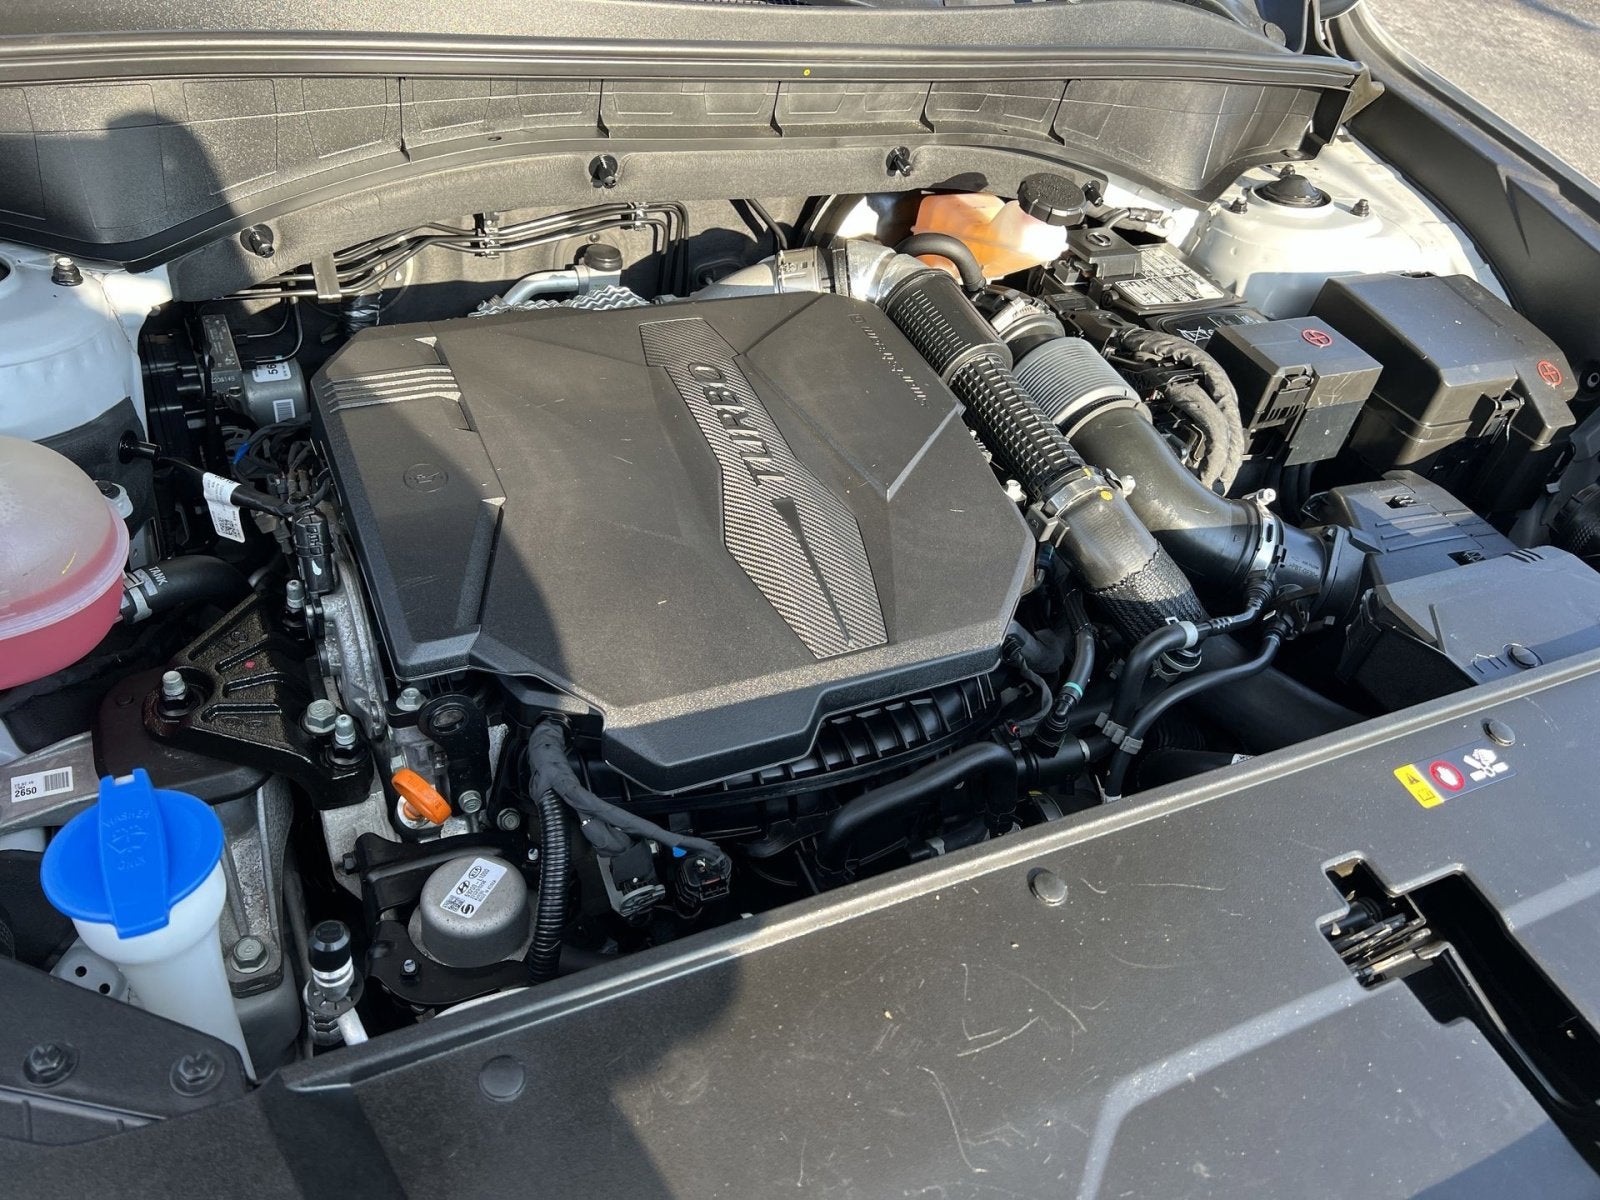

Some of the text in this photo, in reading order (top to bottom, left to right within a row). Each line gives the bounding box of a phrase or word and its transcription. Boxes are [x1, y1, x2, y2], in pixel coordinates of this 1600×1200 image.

[688, 363, 786, 487] TURBO
[148, 566, 168, 586] TANK
[14, 786, 37, 798] 2650
